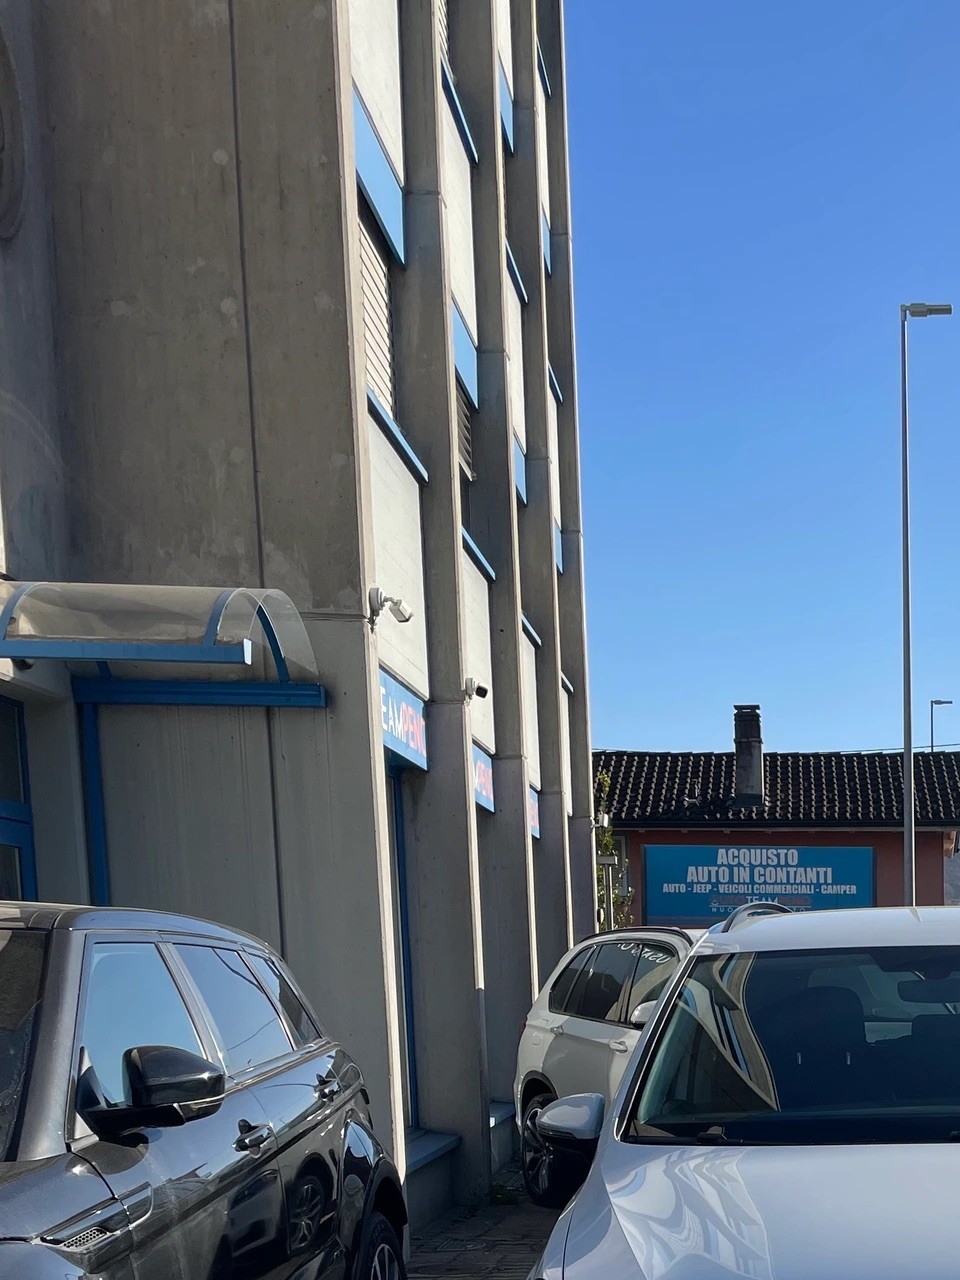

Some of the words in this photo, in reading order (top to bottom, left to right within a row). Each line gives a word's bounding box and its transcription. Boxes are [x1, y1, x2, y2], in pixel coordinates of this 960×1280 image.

[717, 848, 799, 866] ACQUISTO
[686, 866, 733, 883] AUTO
[734, 866, 750, 884] IN
[753, 867, 833, 884] CONTANTI
[662, 883, 686, 894] AUTO
[692, 884, 712, 894] JEEP
[718, 884, 752, 894] VEICOLI
[753, 884, 815, 895] COMMERCIALI
[821, 885, 857, 895] CAMPER
